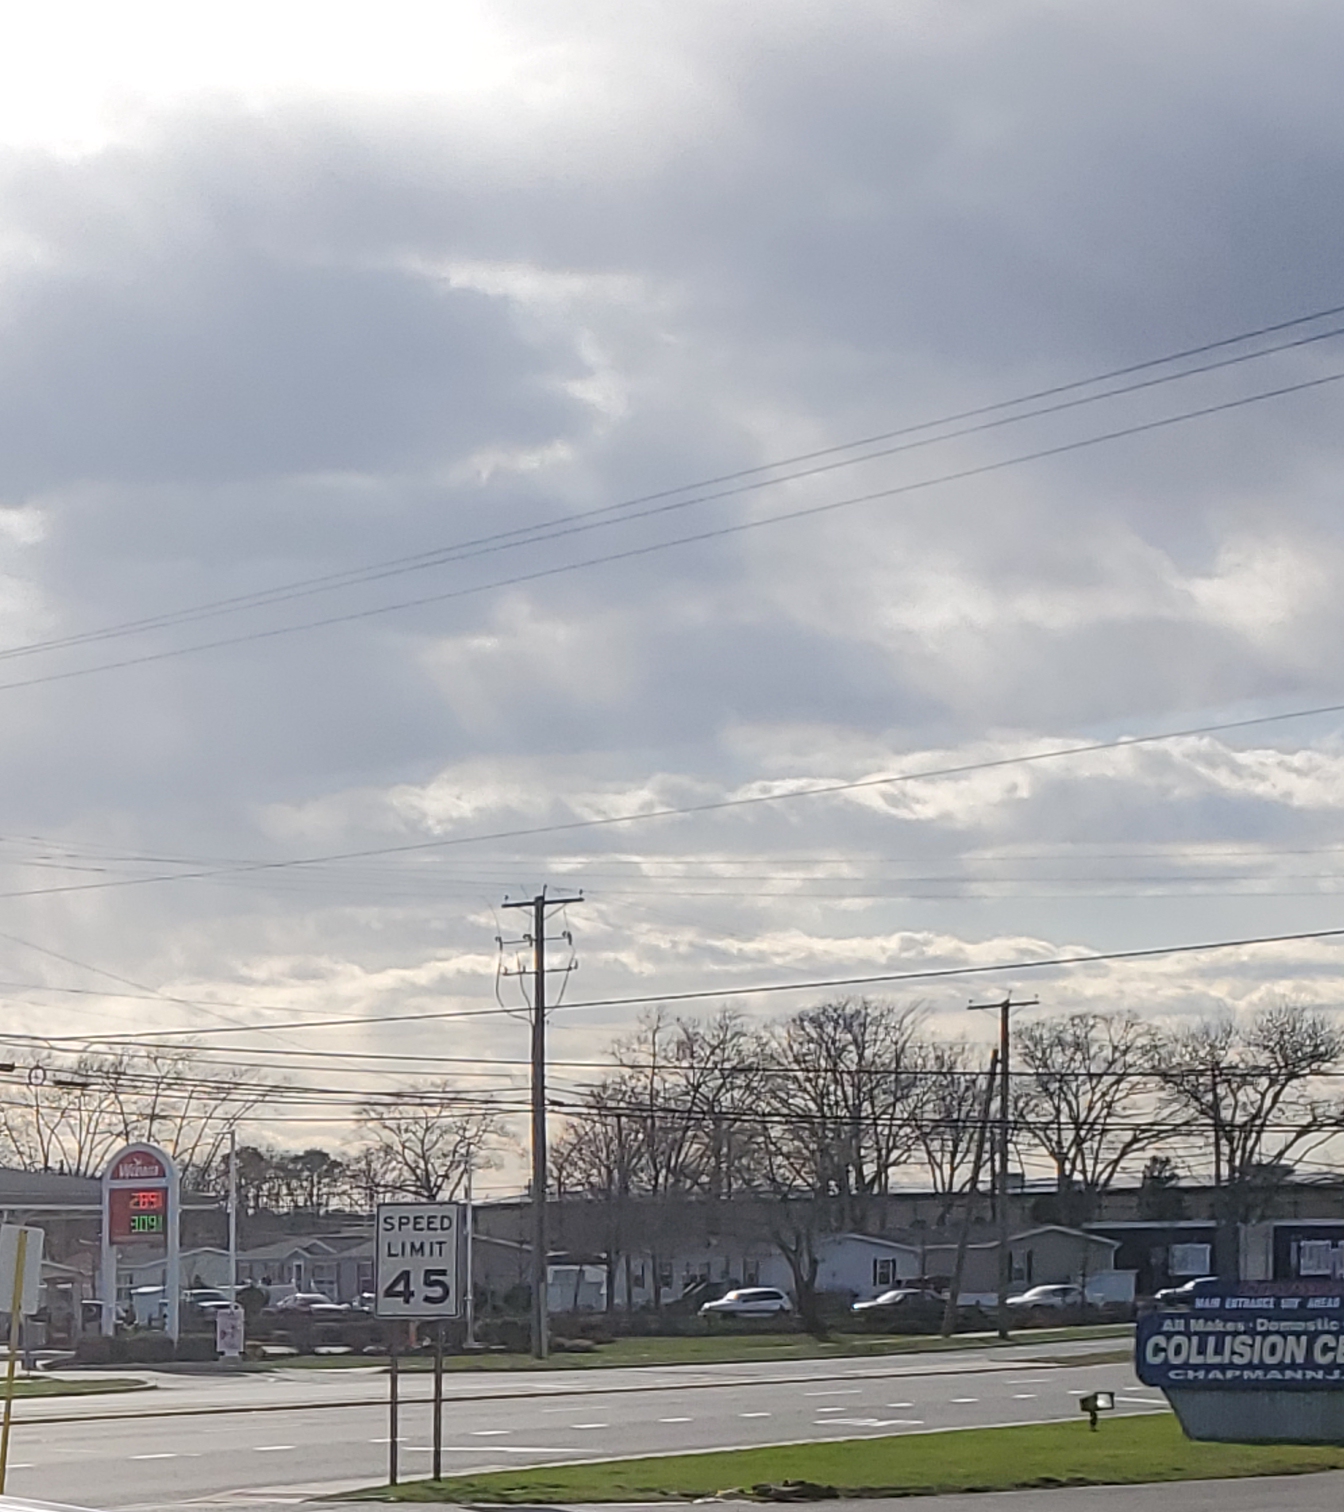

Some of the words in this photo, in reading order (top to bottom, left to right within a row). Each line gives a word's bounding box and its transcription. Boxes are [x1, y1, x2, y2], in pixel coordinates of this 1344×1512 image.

[382, 1215, 452, 1232] SPEED
[386, 1241, 447, 1258] LIMIT
[383, 1269, 450, 1304] 45
[1162, 1319, 1185, 1331] All
[1190, 1319, 1245, 1332] Makes
[1256, 1318, 1340, 1332] Domestic
[1145, 1334, 1308, 1365] COLLISION
